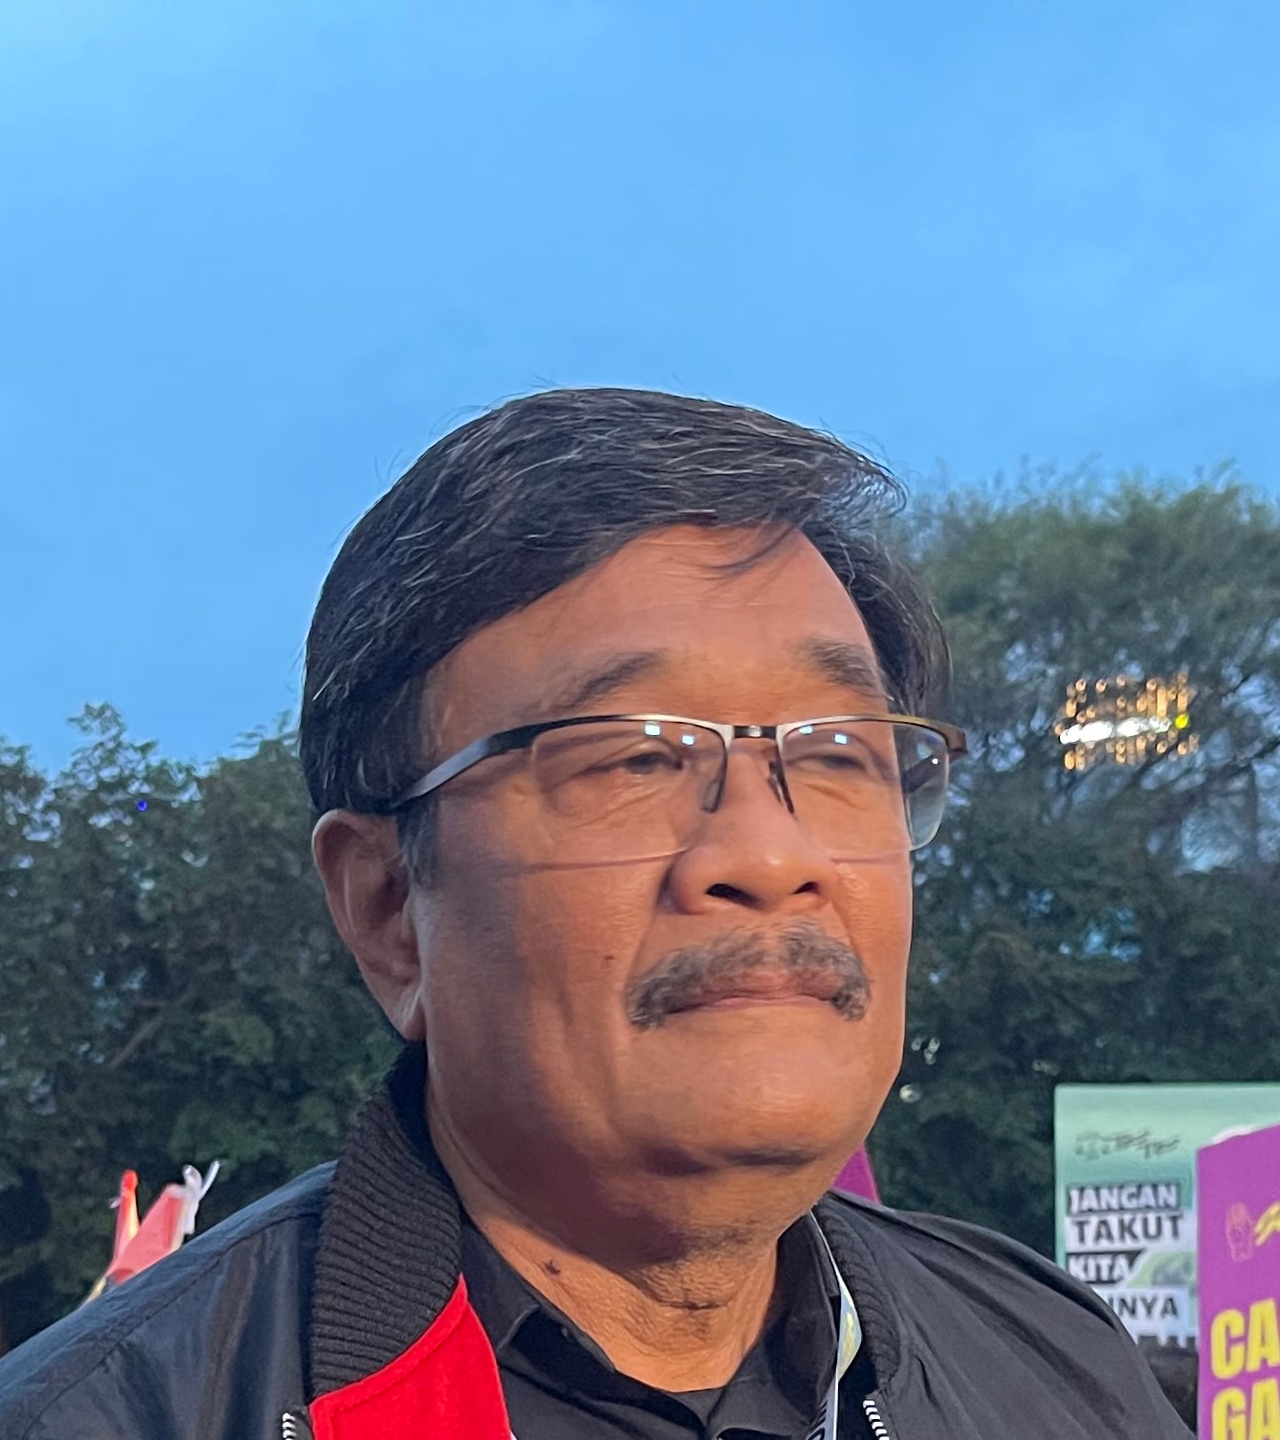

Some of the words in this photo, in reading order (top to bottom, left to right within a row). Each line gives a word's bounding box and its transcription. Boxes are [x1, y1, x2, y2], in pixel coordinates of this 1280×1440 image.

[1070, 1184, 1178, 1215] JANGAN
[1074, 1215, 1182, 1246] TAKUT
[1069, 1255, 1131, 1283] KITA
